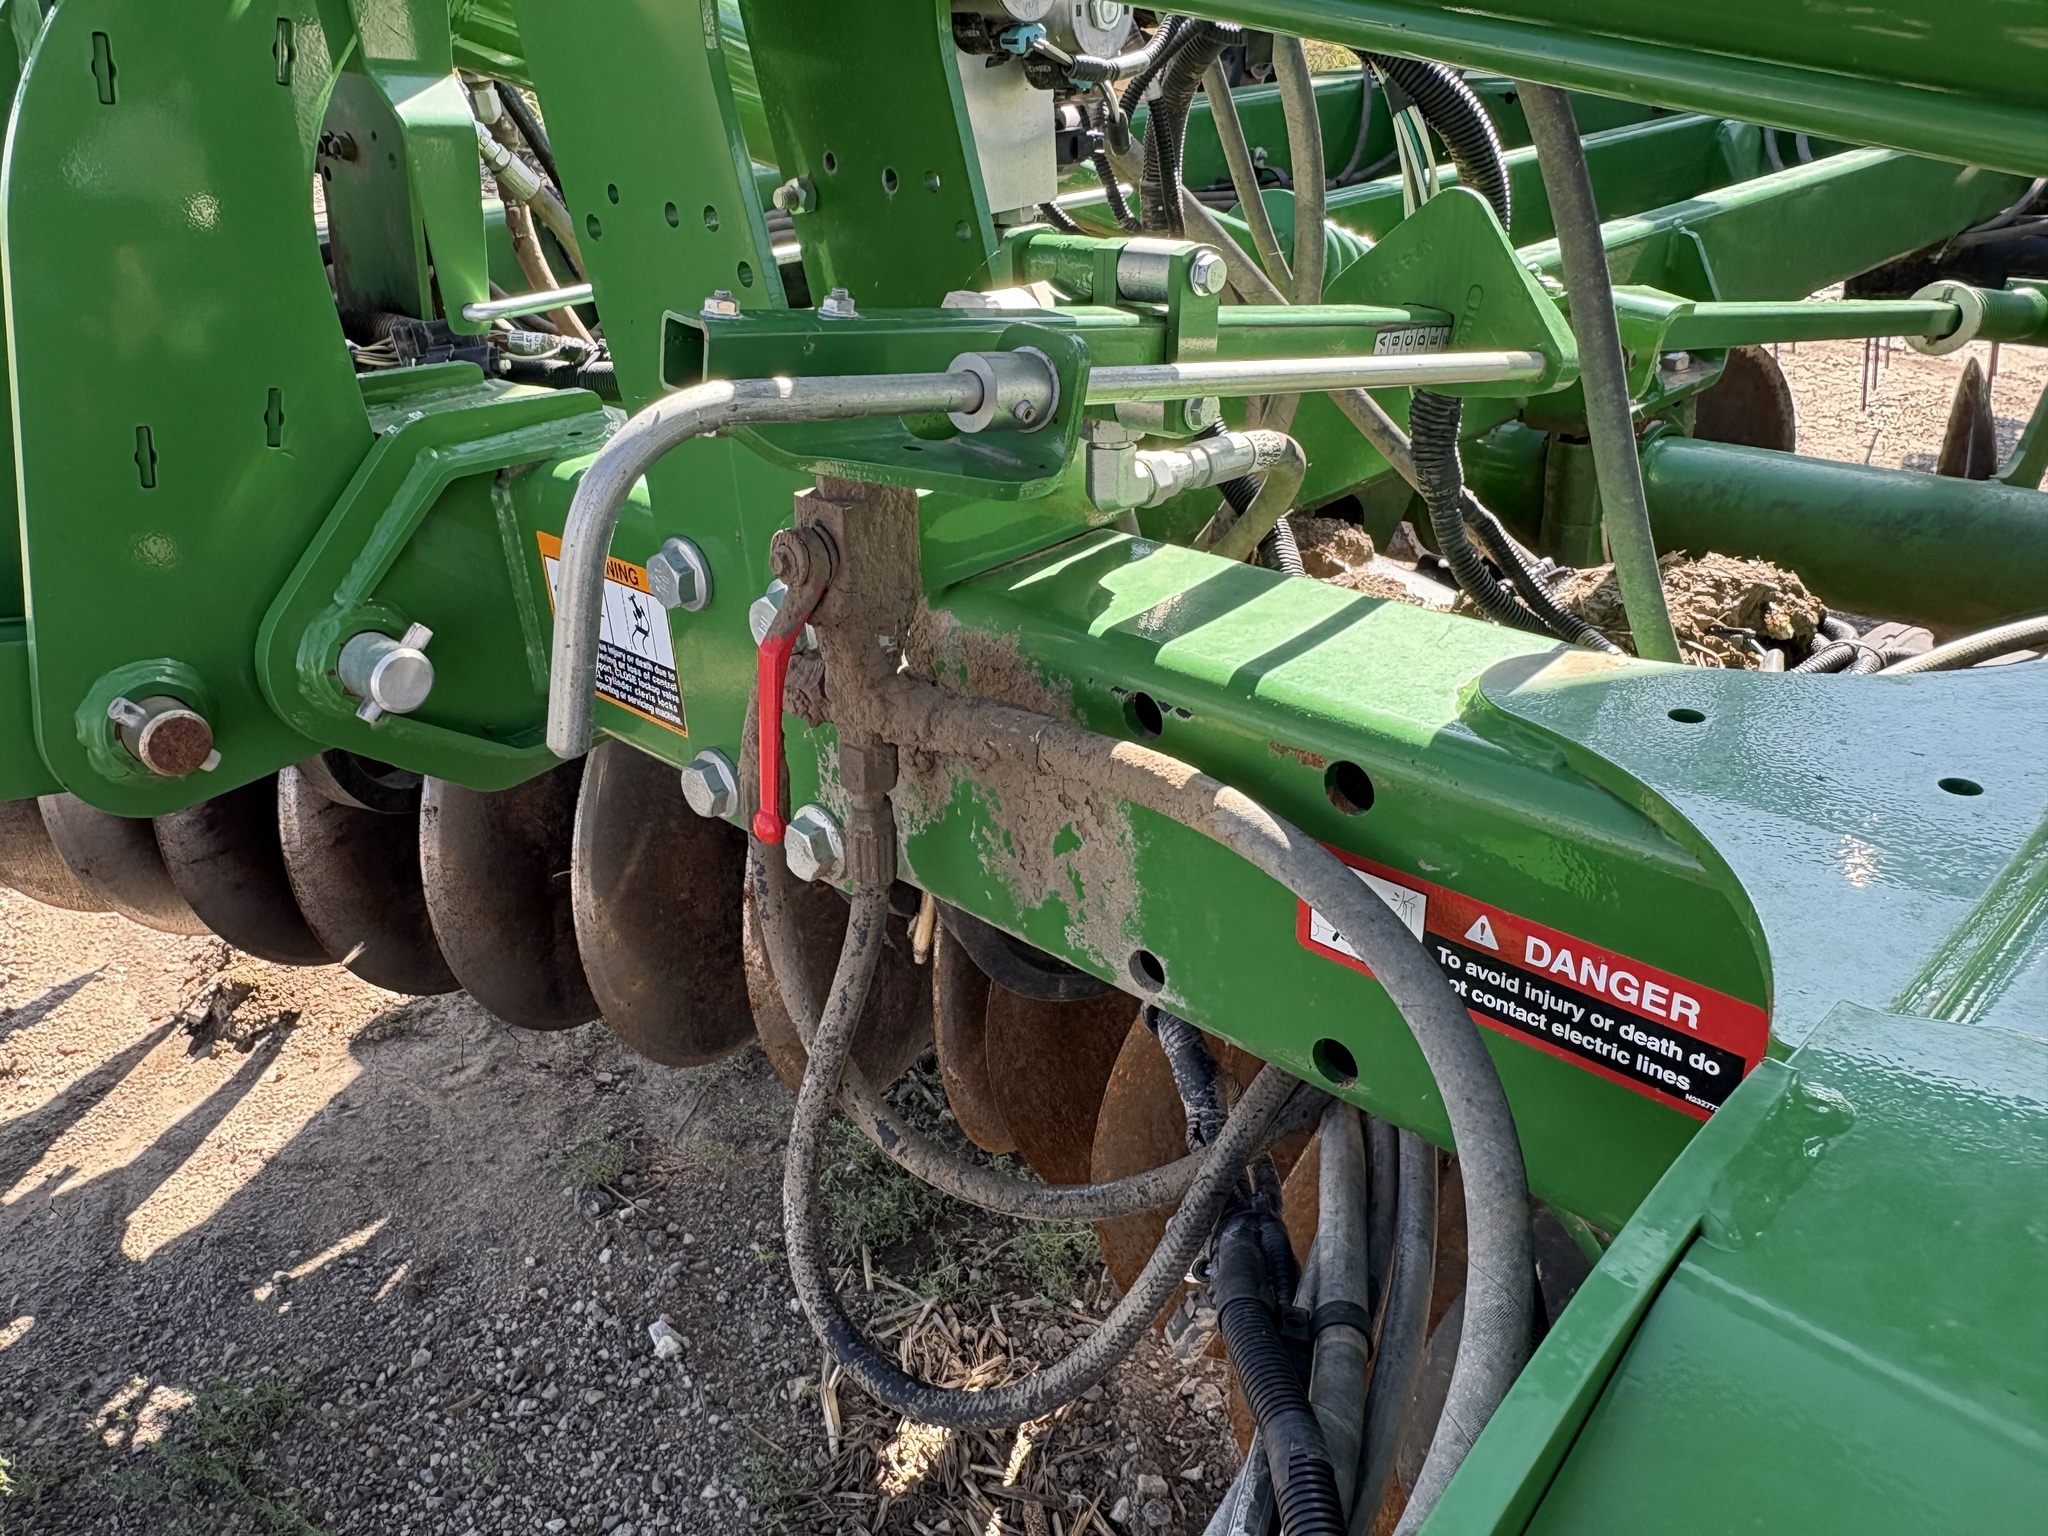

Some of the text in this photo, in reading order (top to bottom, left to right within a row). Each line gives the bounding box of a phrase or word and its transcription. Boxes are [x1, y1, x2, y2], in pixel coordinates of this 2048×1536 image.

[606, 561, 640, 587] NING
[1437, 946, 1720, 1076] To avoid injury or death do
[1525, 936, 1700, 1030] DANGER
[1448, 979, 1691, 1091] ot contact electric lines
